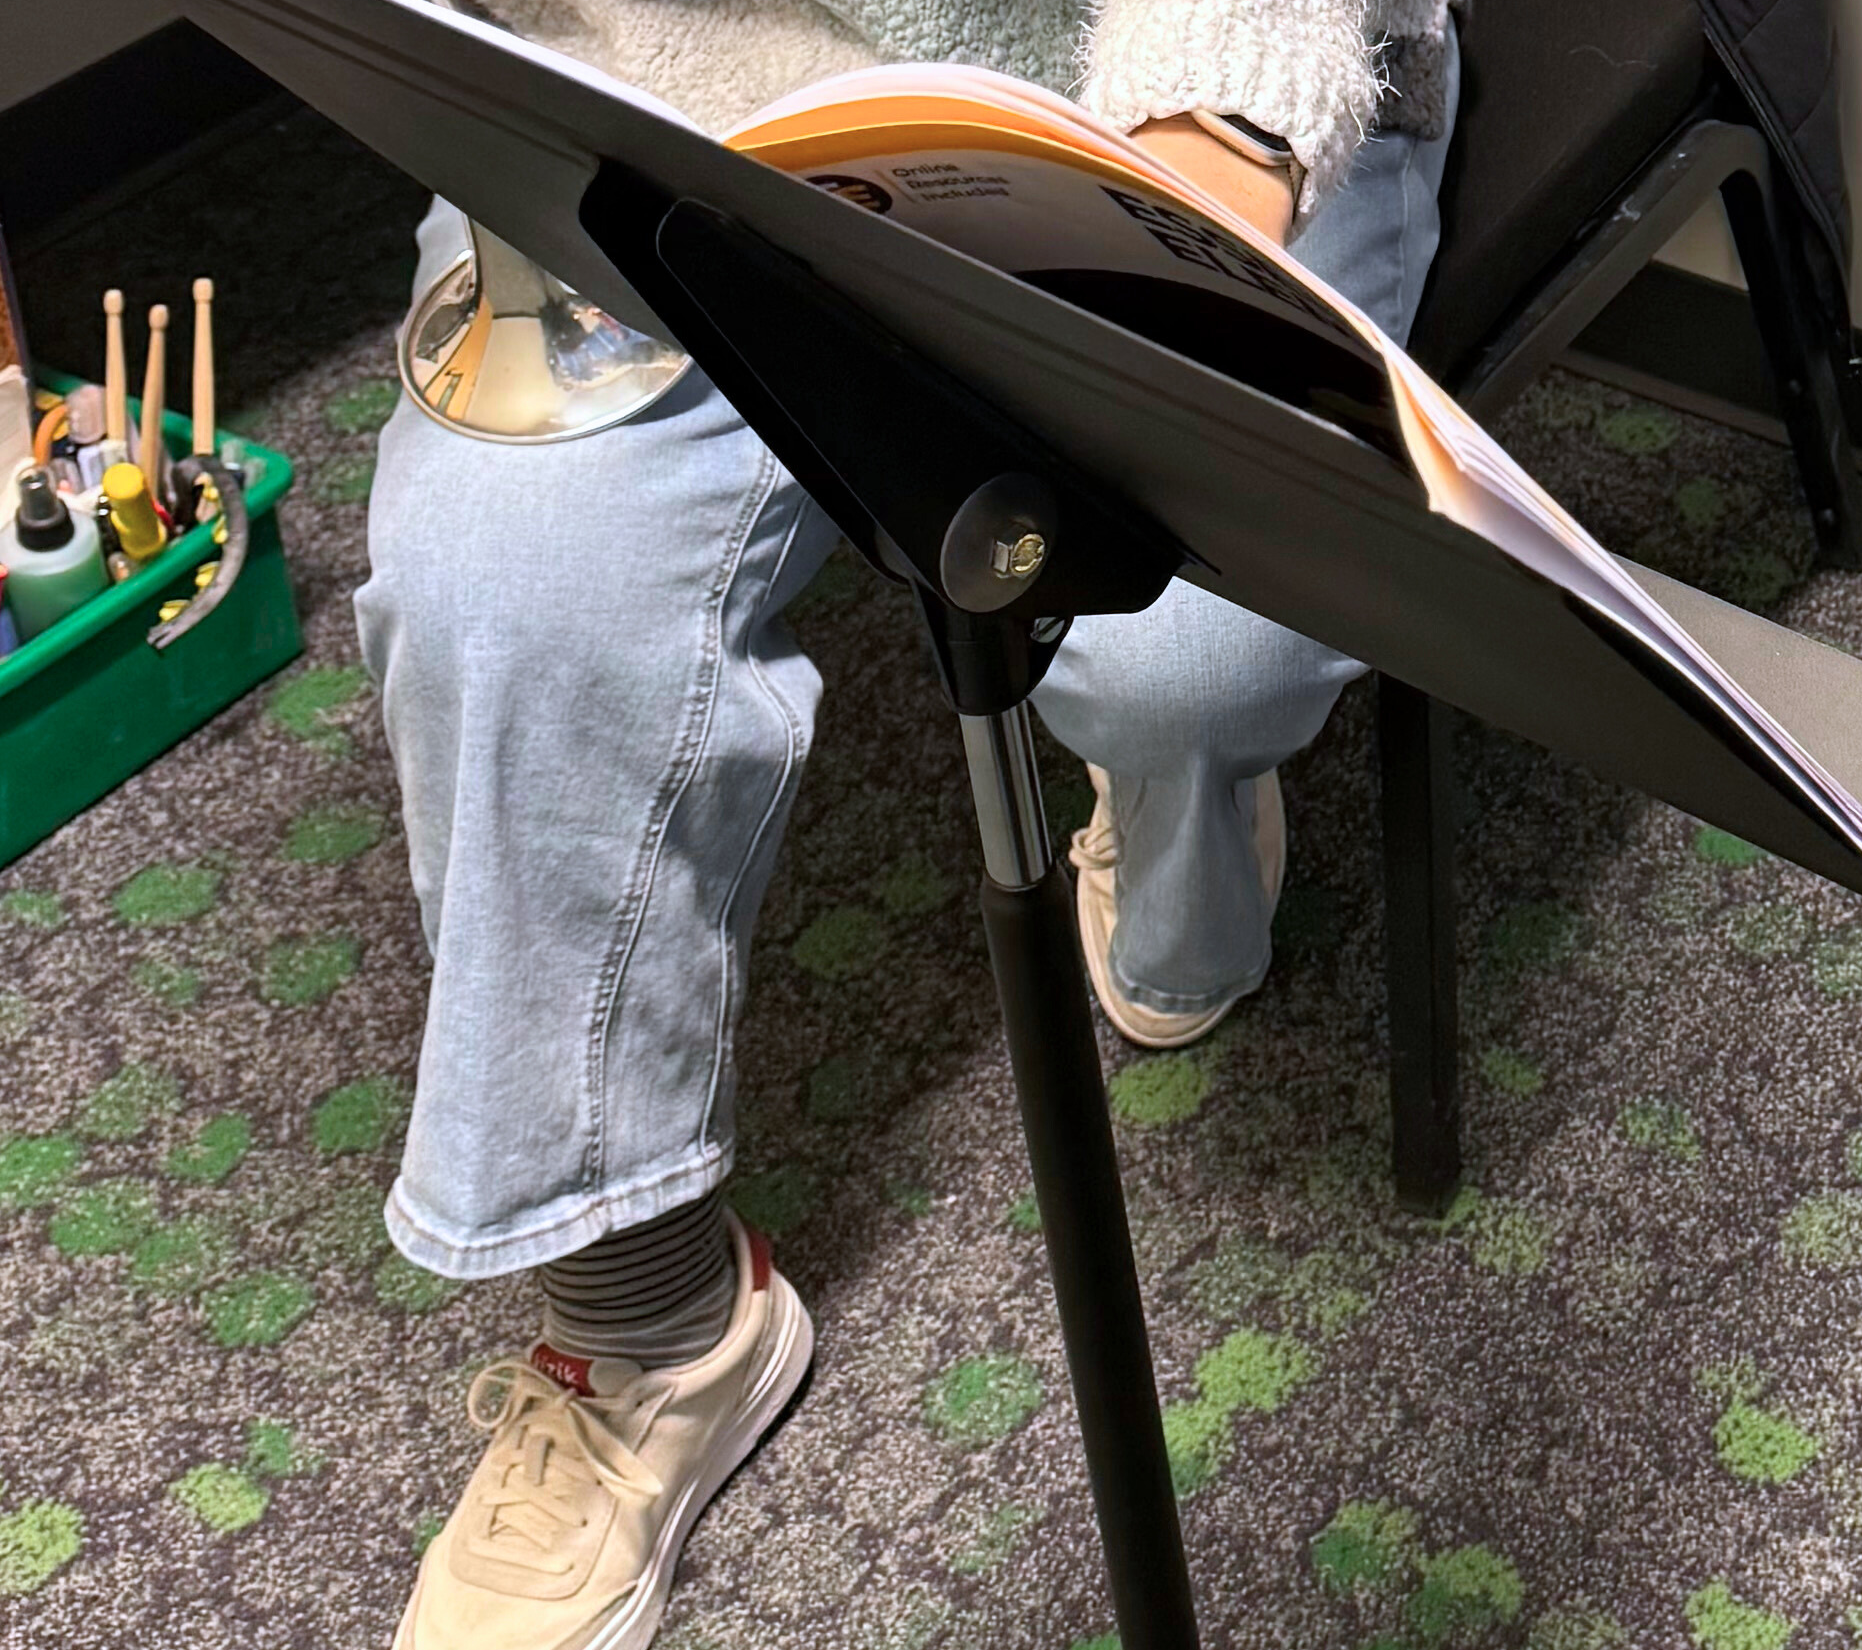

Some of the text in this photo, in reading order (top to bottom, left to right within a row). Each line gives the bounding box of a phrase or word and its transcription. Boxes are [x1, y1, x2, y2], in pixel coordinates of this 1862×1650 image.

[892, 163, 960, 177] Online
[905, 176, 1010, 189] Resources
[920, 187, 1009, 202] Included
